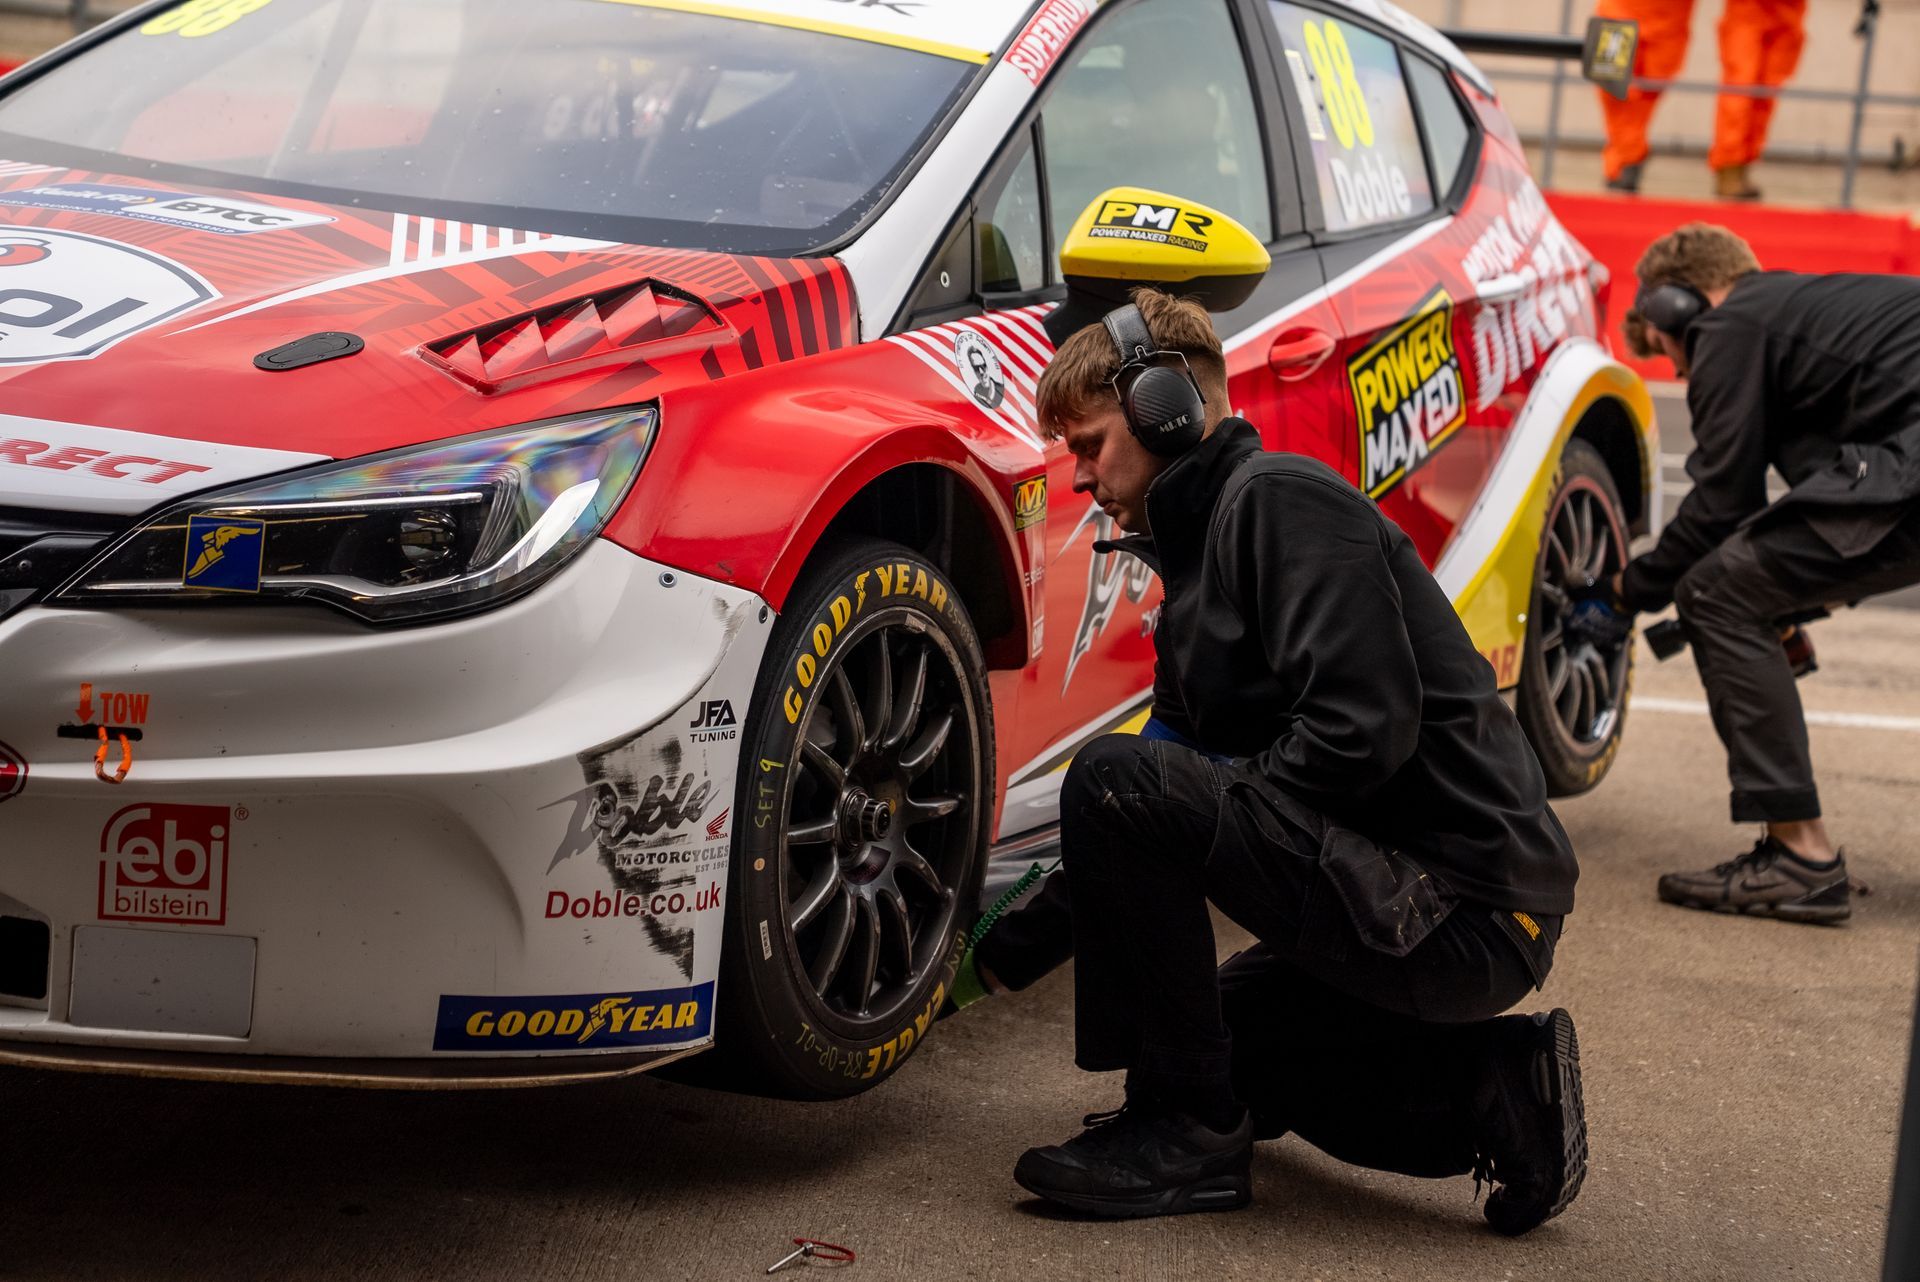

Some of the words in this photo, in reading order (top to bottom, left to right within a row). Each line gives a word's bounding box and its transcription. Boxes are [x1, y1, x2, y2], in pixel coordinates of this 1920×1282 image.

[1303, 19, 1374, 149] 88
[1330, 153, 1411, 222] Doble
[161, 201, 294, 226] BTCC
[1098, 201, 1213, 237] PMR
[1090, 228, 1129, 239] POWER
[1130, 231, 1167, 243] MAXED
[1167, 236, 1206, 251] RACING
[1357, 310, 1449, 432] POWER
[1366, 363, 1460, 491] MAXED
[100, 692, 149, 724] TOW
[690, 699, 737, 729] JFA
[690, 730, 736, 743] TUNING
[754, 781, 776, 829] SET
[99, 807, 226, 892] febi
[705, 833, 729, 842] HONDA
[615, 844, 730, 868] MOTORCYCLES
[695, 864, 710, 873] EST
[114, 888, 209, 917] bilstein
[544, 880, 721, 919] Doble.co.uk
[860, 981, 945, 1080] EAGLE
